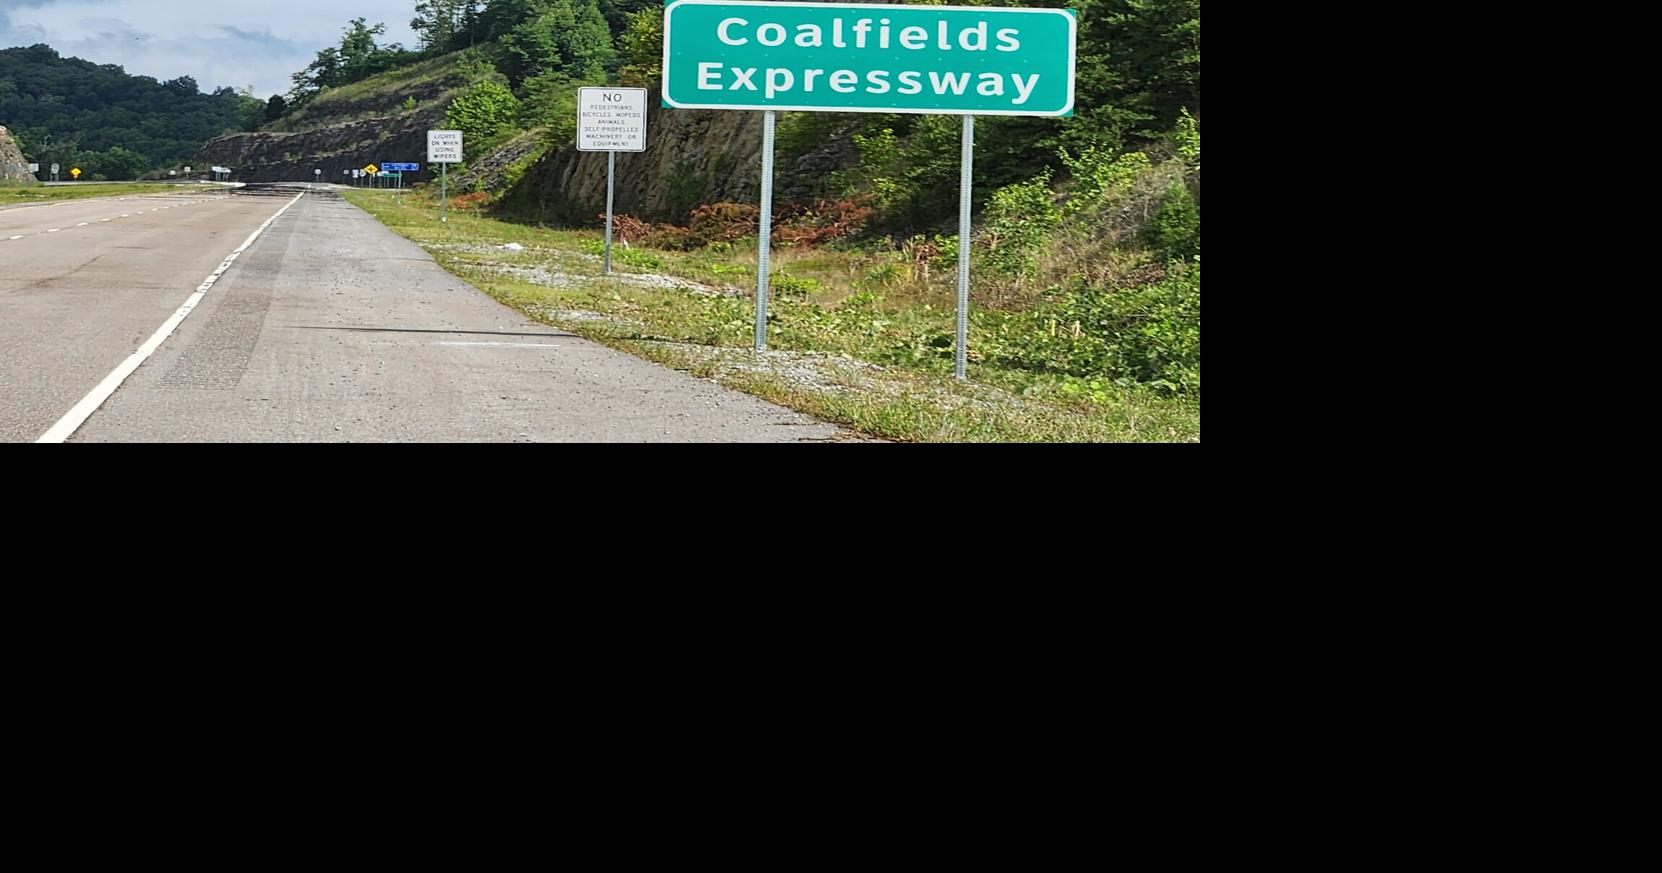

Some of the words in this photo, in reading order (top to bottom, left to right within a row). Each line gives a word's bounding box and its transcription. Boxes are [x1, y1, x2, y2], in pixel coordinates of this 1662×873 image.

[716, 17, 1021, 53] Coalfields
[603, 93, 622, 102] NO
[696, 61, 1040, 105] Expressway
